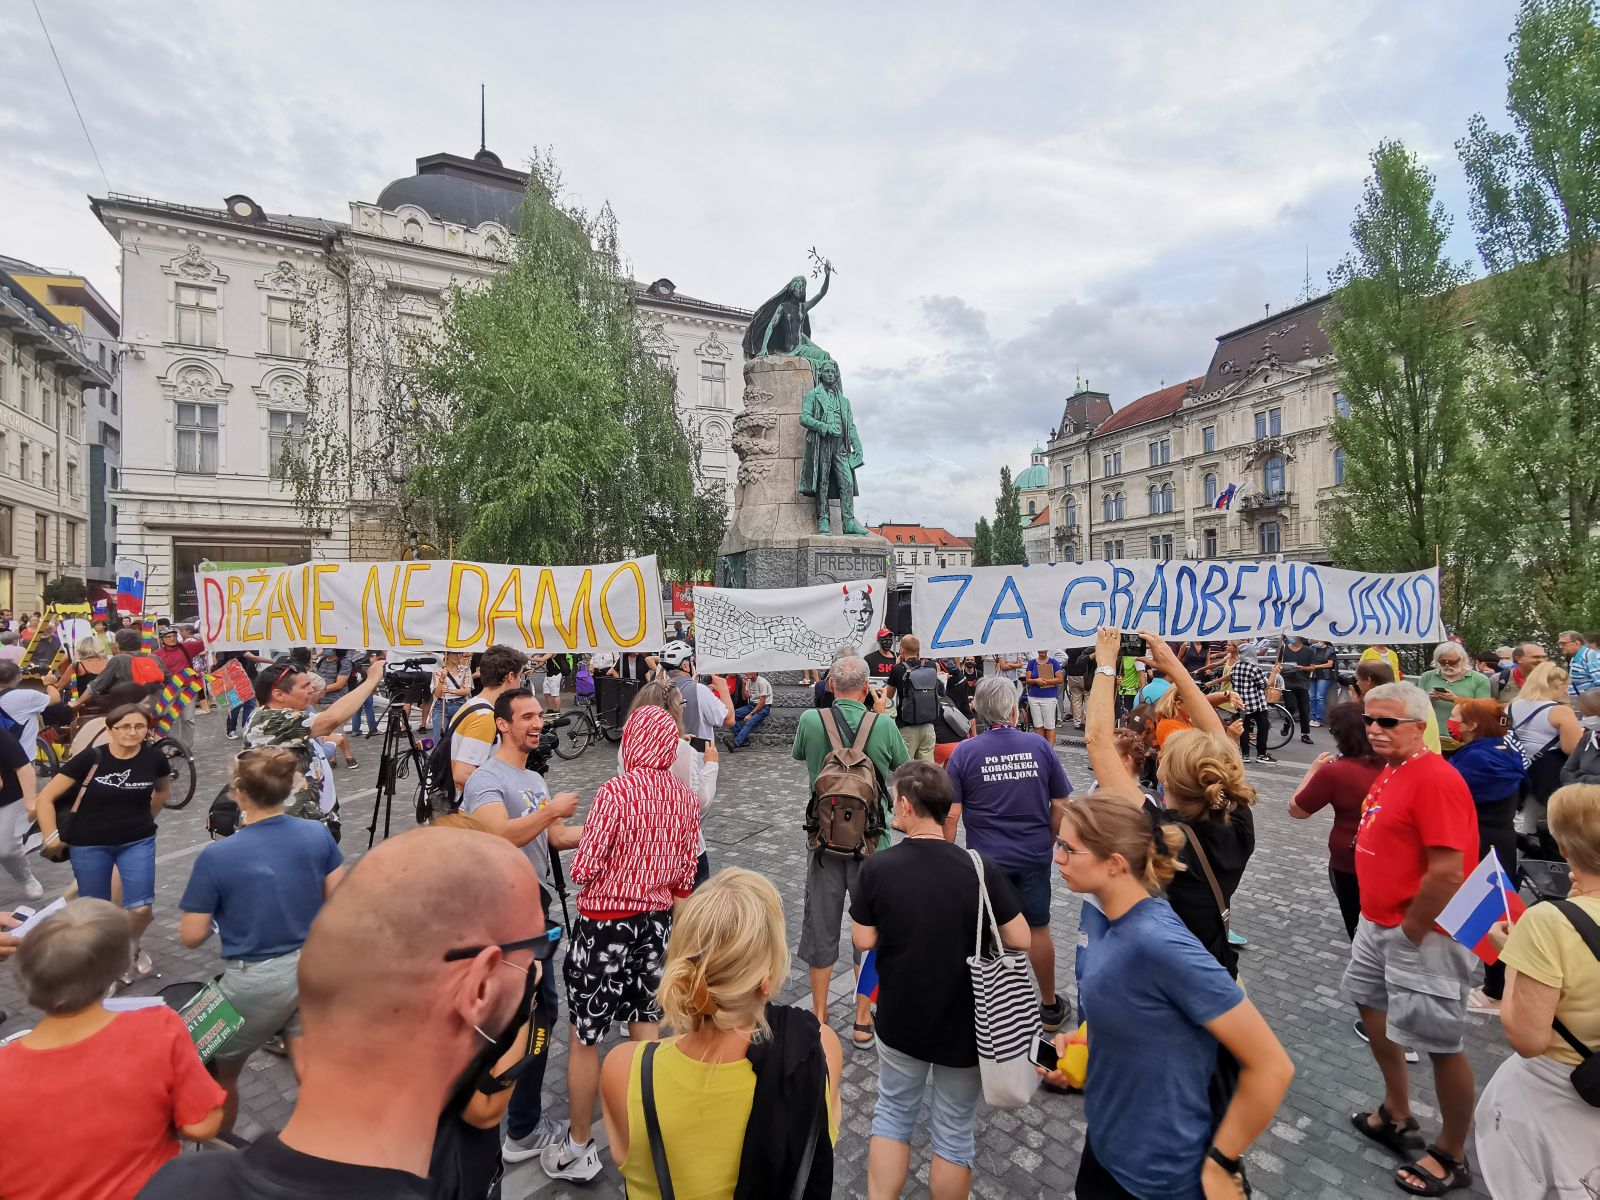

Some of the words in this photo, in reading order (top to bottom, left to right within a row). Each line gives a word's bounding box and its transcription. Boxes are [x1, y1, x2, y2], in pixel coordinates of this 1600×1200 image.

[203, 564, 340, 645] DRŽAVE
[361, 563, 432, 648] NE
[445, 561, 646, 649] DAMO
[927, 574, 1033, 649] ZA
[1059, 561, 1324, 637] GRADBENO
[1328, 573, 1435, 638] JAMO
[985, 756, 998, 764] PO
[981, 761, 1039, 773] KOROŠKEGA
[983, 769, 1039, 782] BATALJONA
[197, 1013, 208, 1022] be
[201, 1035, 222, 1057] behind
[221, 1026, 231, 1040] you
